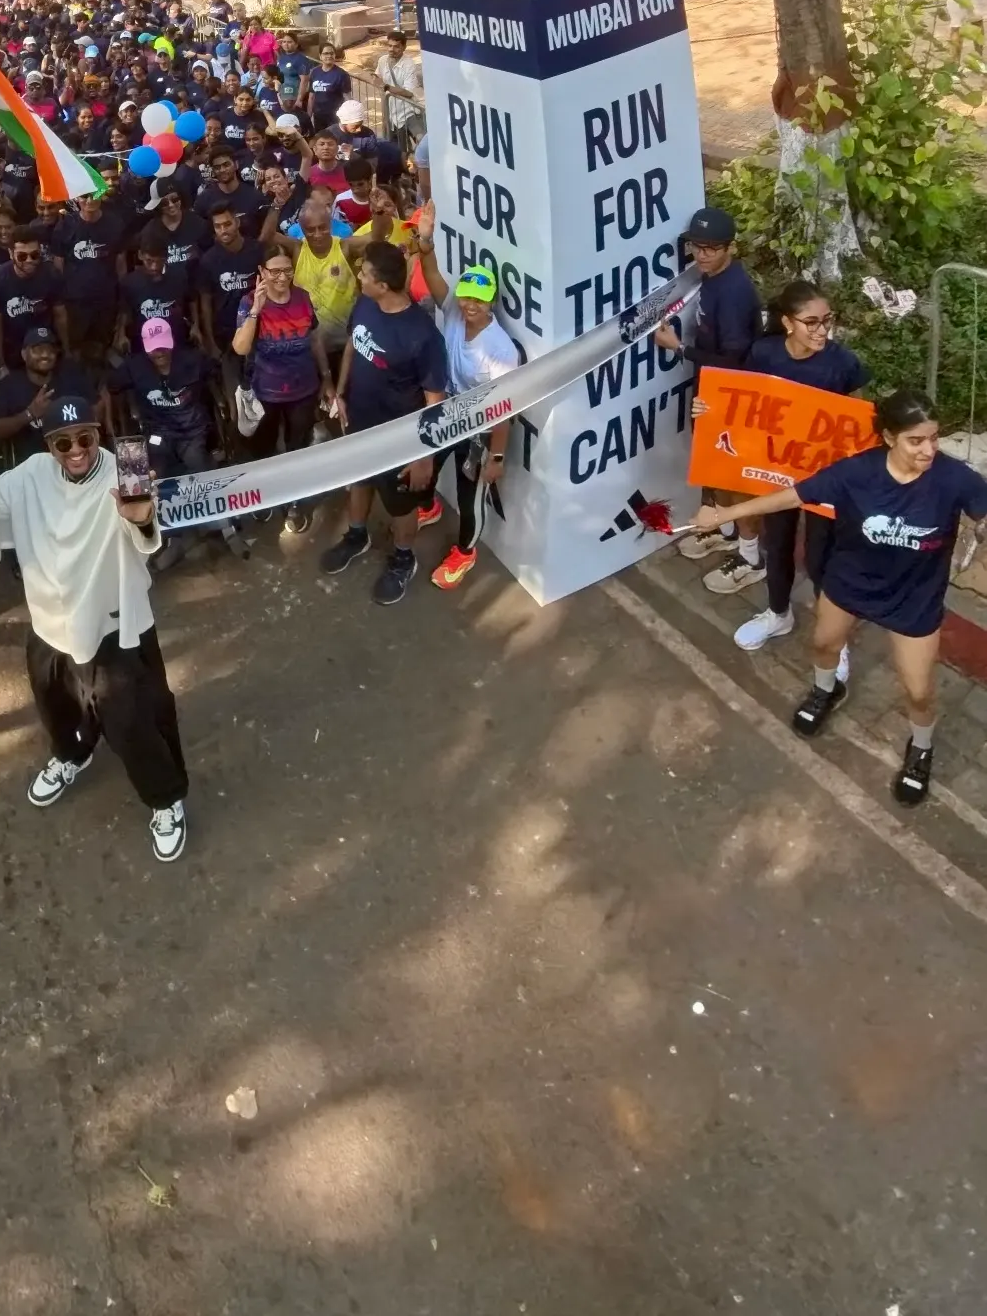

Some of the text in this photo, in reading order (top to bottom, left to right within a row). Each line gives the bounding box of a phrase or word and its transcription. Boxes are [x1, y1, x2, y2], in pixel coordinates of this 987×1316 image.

[423, 6, 527, 53] MUMBAI RUN
[448, 93, 515, 172] RUN
[583, 83, 667, 173] RUN
[456, 165, 518, 248] FOR
[593, 167, 671, 252] FOR
[62, 403, 78, 421] NY
[435, 411, 485, 444] WORLD
[485, 398, 513, 422] RUN
[444, 396, 479, 417] WINGS
[718, 386, 793, 436] THE
[570, 376, 696, 485] CAN'T
[179, 480, 221, 496] WINGS
[187, 491, 210, 503] LIFE
[744, 468, 793, 487] STRAVA
[166, 488, 262, 522] WORLD RUN
[875, 534, 921, 550] WORLD
